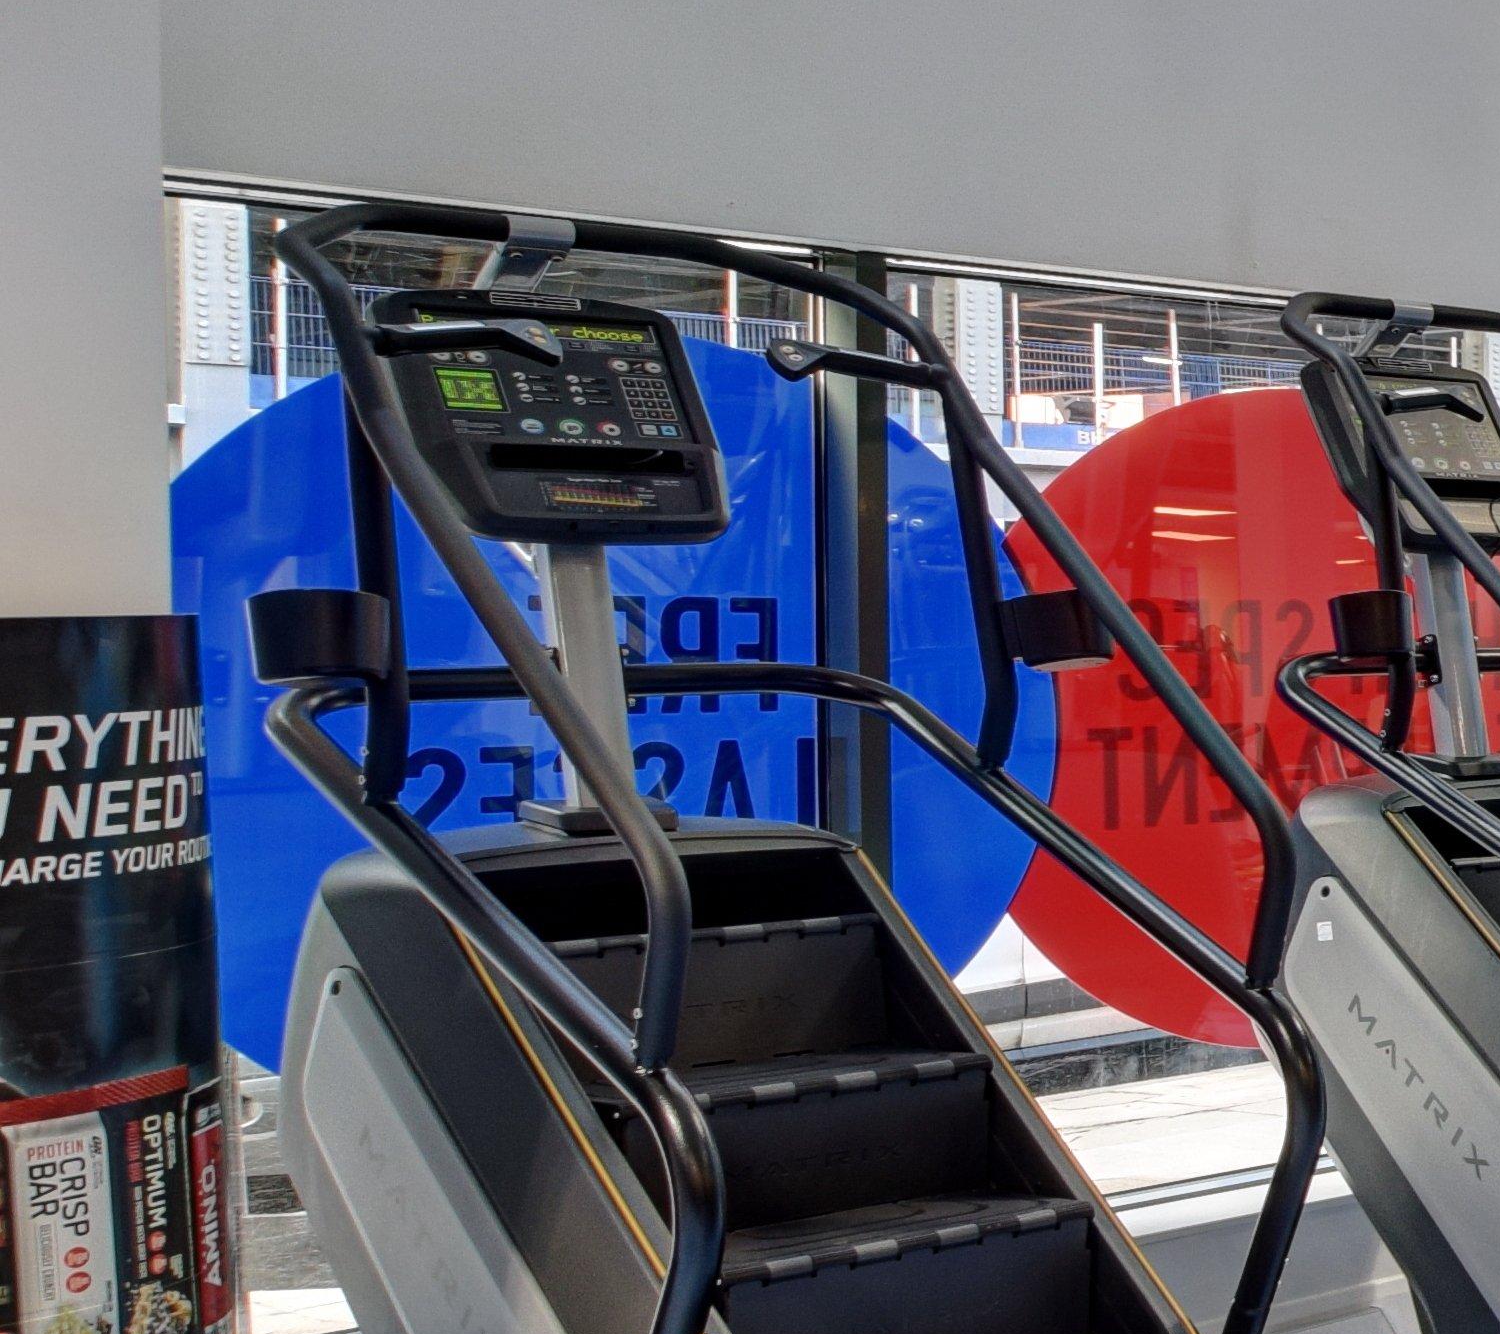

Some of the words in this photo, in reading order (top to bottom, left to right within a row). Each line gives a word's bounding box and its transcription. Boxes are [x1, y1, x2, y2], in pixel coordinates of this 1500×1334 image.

[572, 326, 645, 343] choose
[551, 436, 624, 447] MATRIX
[38, 774, 188, 843] NEED
[0, 851, 104, 887] ARGE
[112, 842, 174, 875] YOUR
[1348, 994, 1490, 1182] MATRIX
[27, 1140, 85, 1162] PROTEIN
[142, 1114, 169, 1228] OPTIMUM
[28, 1163, 60, 1219] BAR
[59, 1157, 91, 1237] CRISP
